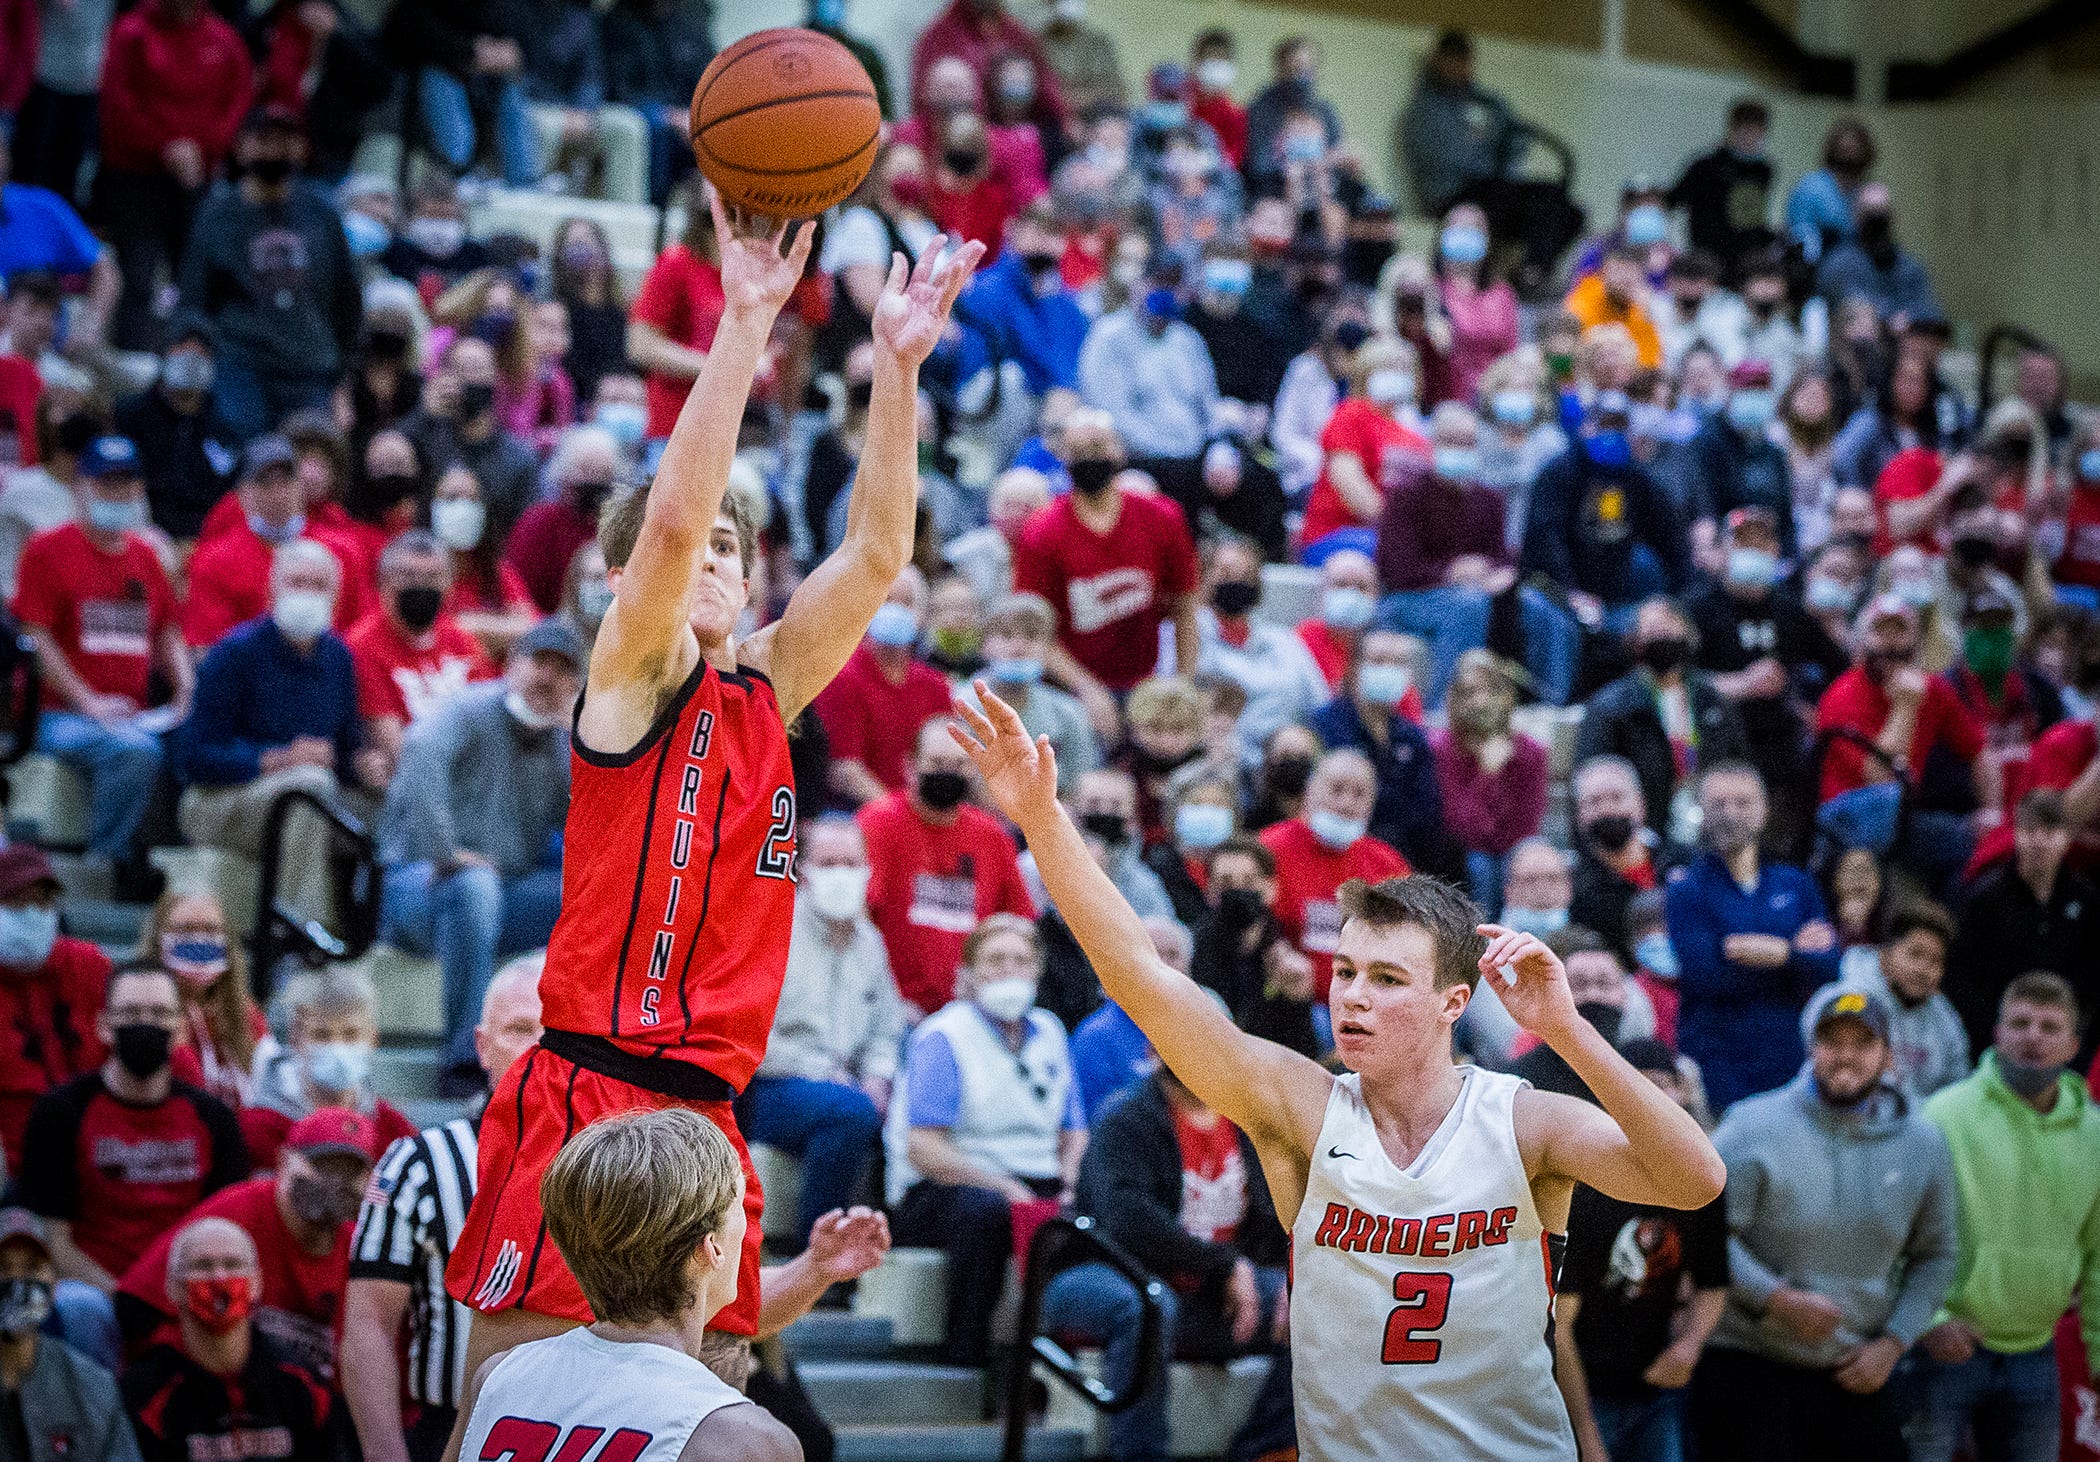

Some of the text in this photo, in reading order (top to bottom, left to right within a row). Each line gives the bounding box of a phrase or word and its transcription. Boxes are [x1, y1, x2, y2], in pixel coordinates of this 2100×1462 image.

[641, 709, 715, 1026] BRUINS
[755, 786, 797, 883] 2
[1315, 1202, 1518, 1257] RAIDERS
[1381, 1272, 1454, 1365] 2
